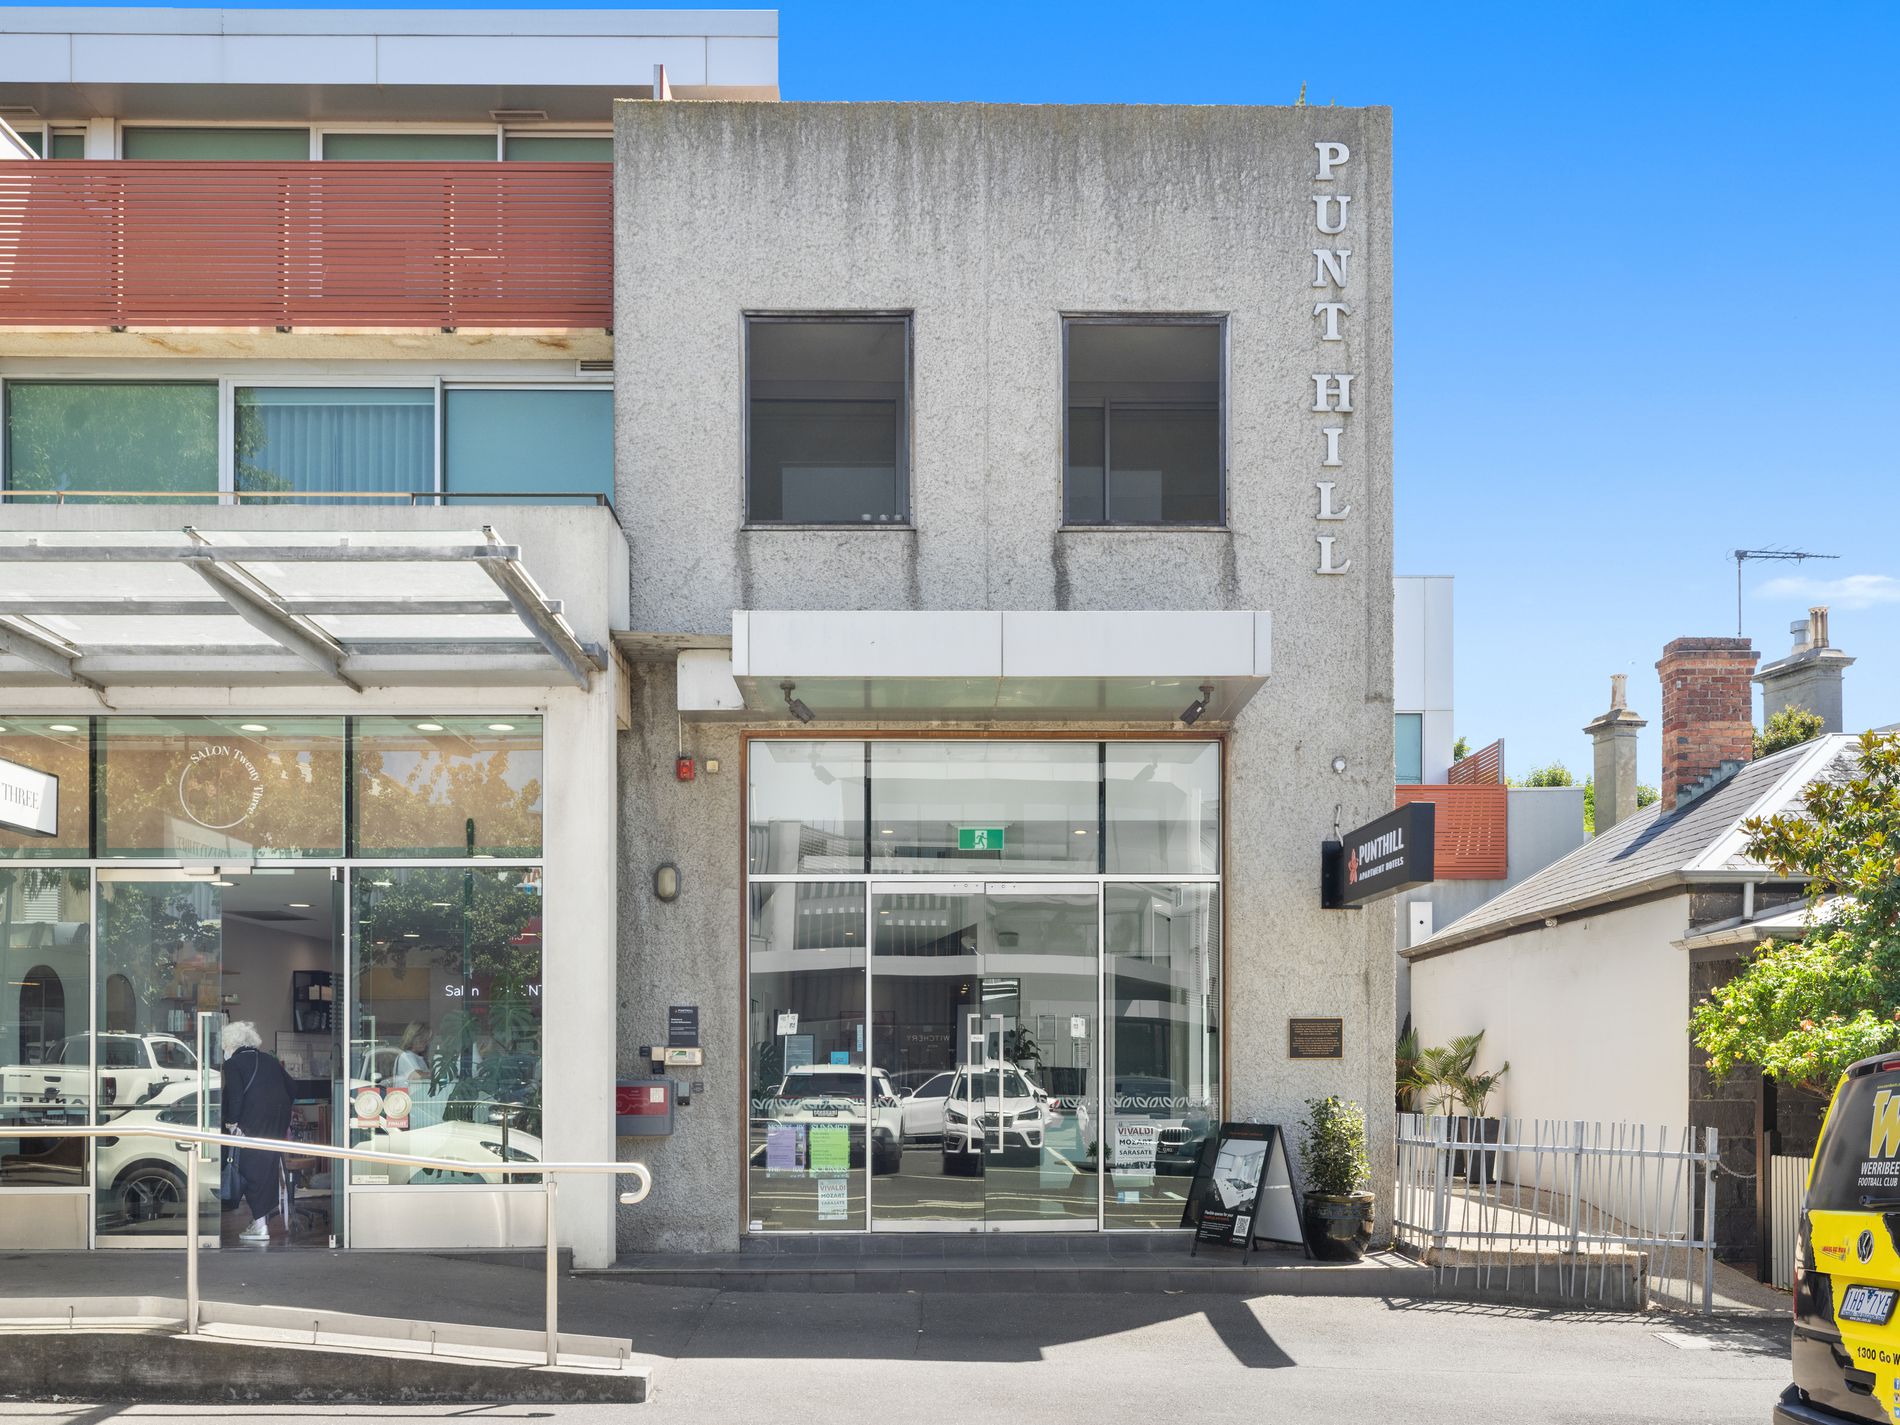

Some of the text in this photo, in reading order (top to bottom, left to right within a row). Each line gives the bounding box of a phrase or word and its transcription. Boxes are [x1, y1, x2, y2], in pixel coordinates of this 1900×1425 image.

[190, 745, 264, 814] SALON Twenty Three
[1, 782, 39, 810] THREE
[1359, 827, 1404, 866] PUNTHILL
[1358, 856, 1404, 881] APARTMENT HOTELS
[445, 984, 480, 997] Saln
[1118, 1127, 1154, 1135] VIVALDI
[1861, 1161, 1900, 1175] WERRIBEE
[1858, 1177, 1898, 1187] FOOTBALL CLUB
[1845, 1290, 1866, 1312] 1HB
[1857, 1347, 1877, 1361] 1300
[1878, 1351, 1891, 1364] Go
